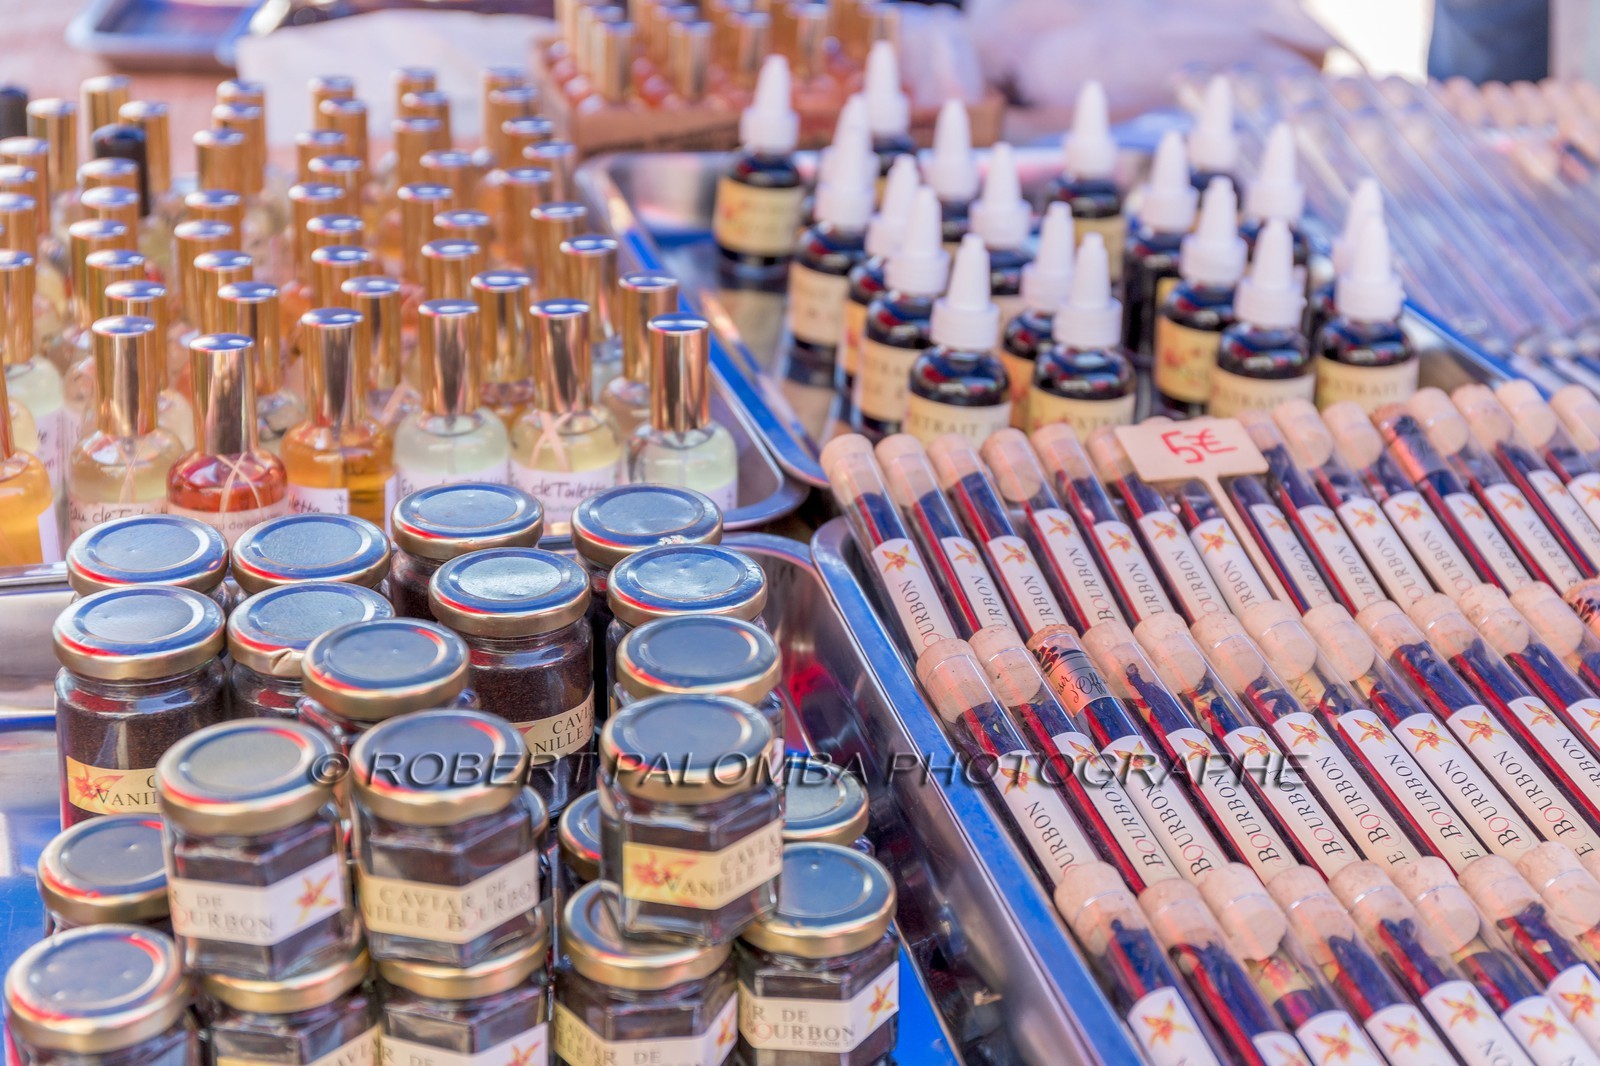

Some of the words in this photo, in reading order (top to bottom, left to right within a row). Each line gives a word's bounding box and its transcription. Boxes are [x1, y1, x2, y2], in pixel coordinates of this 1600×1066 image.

[1161, 427, 1238, 463] 5€
[1065, 547, 1117, 621] BOURBON
[1373, 537, 1424, 604] OURBON
[1419, 530, 1472, 593] OURBON
[1095, 779, 1163, 866] BOURBON
[1141, 783, 1213, 876] BOURBON
[1209, 774, 1280, 863] BOURBON
[1267, 769, 1345, 856] BOURBON
[1316, 756, 1391, 844] BOURBON
[1384, 754, 1464, 839] BOURBON
[1440, 759, 1520, 847] BOURBON
[1493, 750, 1577, 836] BOURBON
[379, 886, 473, 912] CAVIAR
[782, 1008, 810, 1023] DE
